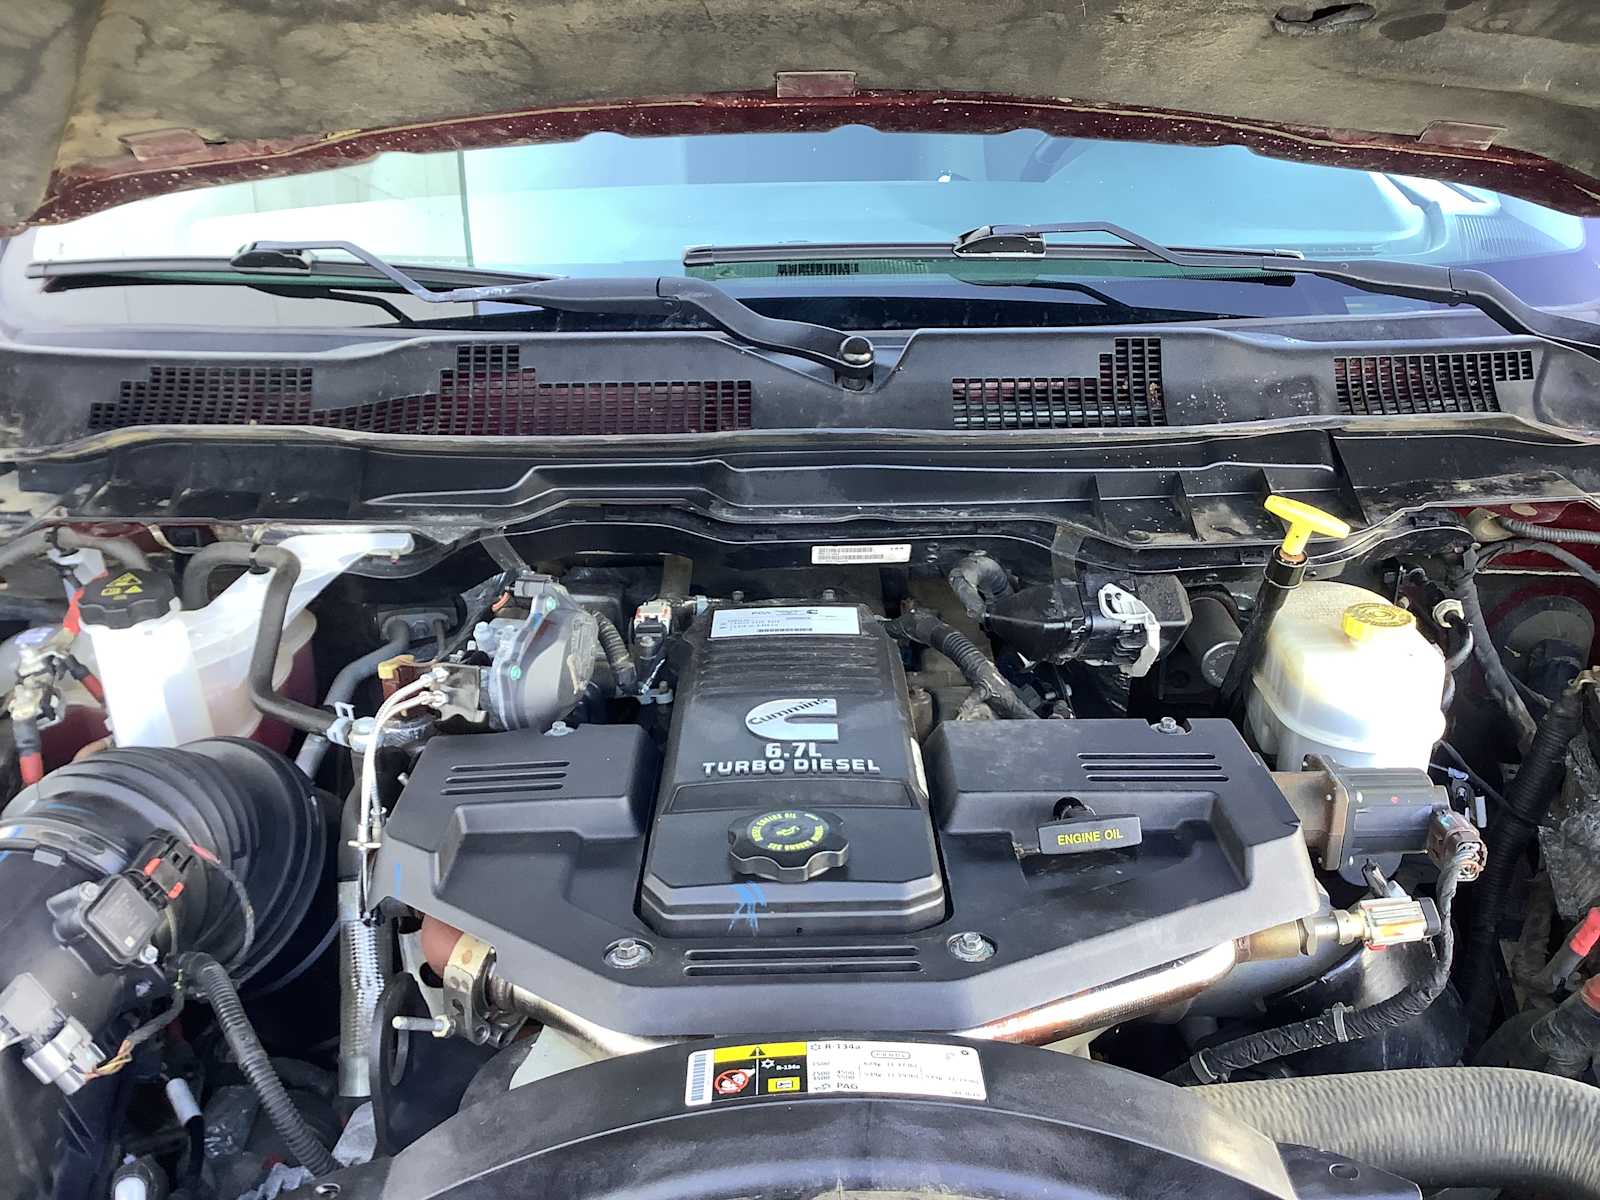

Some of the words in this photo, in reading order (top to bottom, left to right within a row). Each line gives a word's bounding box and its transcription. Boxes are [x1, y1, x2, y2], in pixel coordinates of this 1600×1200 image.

[748, 697, 829, 726] Cummins
[765, 742, 822, 759] 6.7L
[702, 759, 785, 777] TURBO
[793, 758, 881, 775] DIESEL
[1057, 831, 1101, 846] ENGINE
[1104, 828, 1124, 840] OIL
